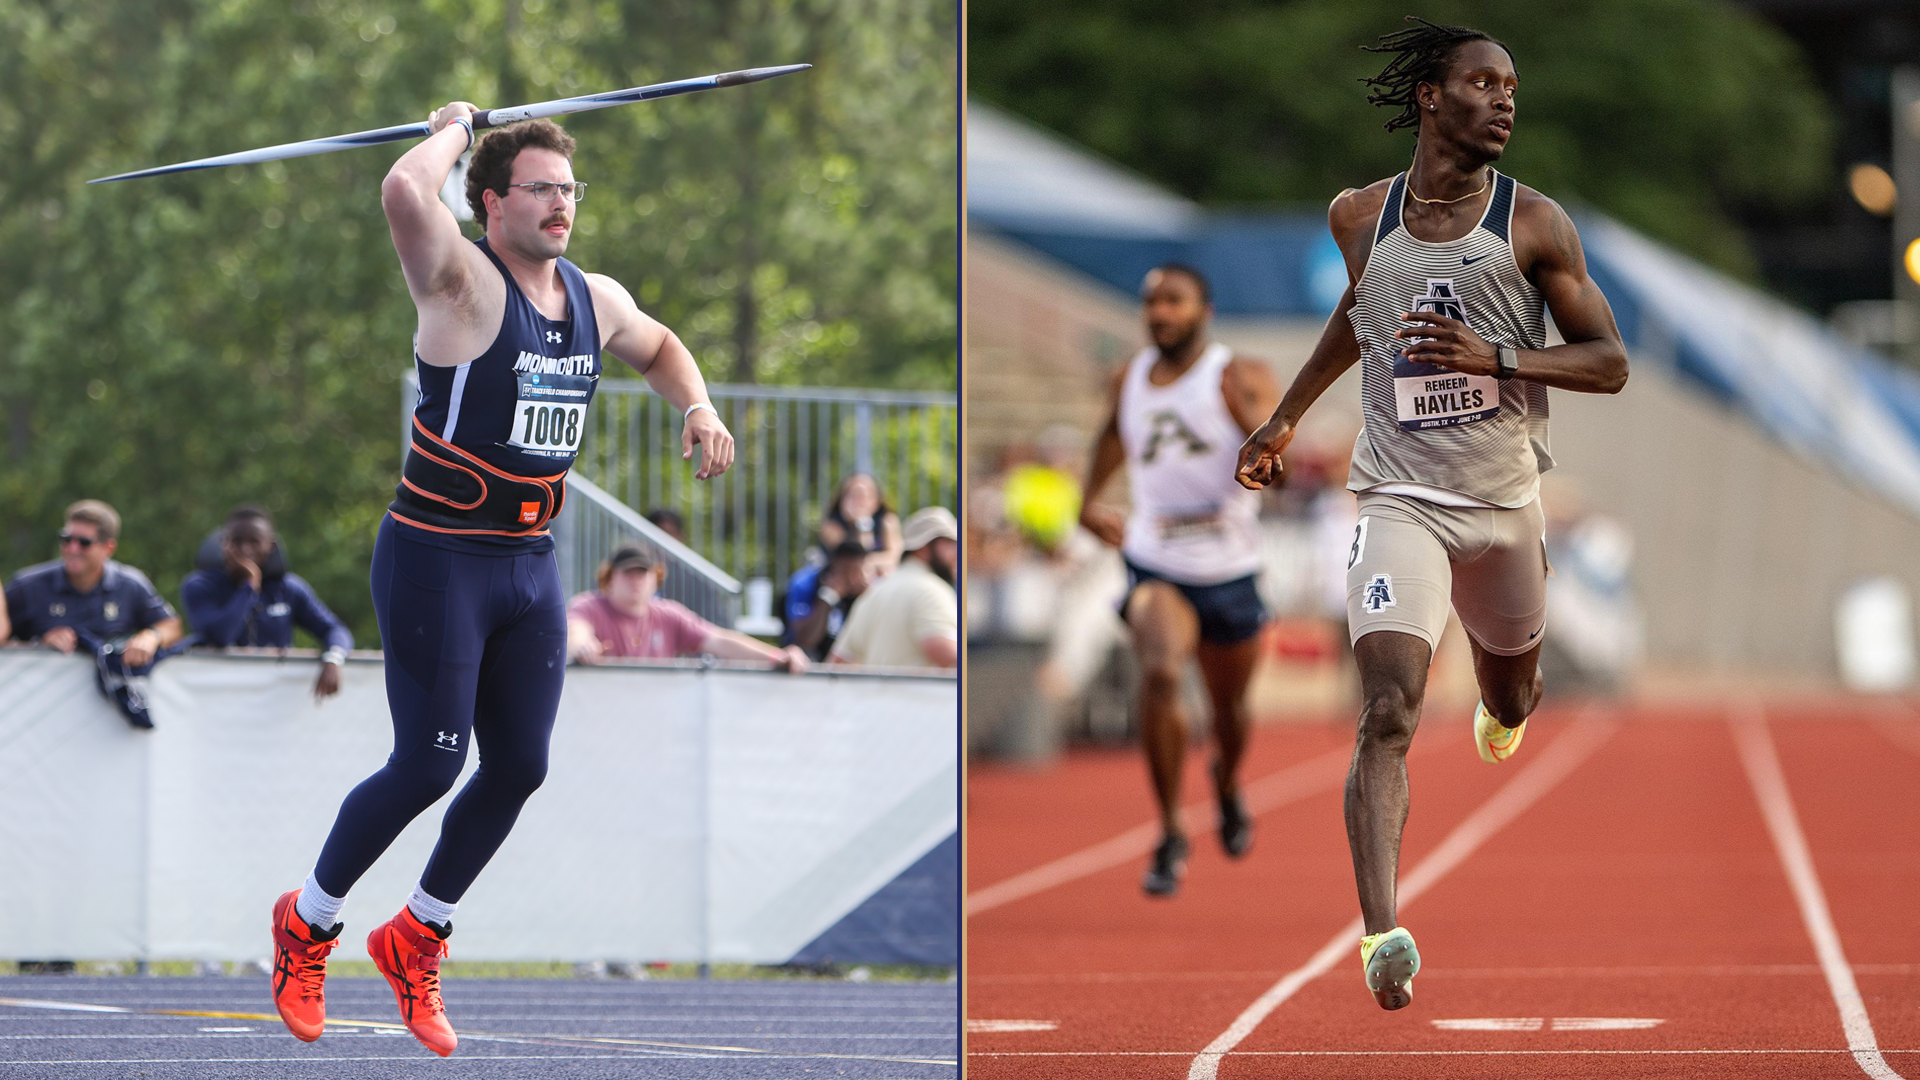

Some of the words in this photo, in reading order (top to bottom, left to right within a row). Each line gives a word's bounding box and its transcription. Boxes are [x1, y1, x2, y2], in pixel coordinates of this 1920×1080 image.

[514, 351, 593, 375] MONMOUTH
[1425, 376, 1468, 392] REHEEM
[1414, 388, 1484, 416] HAYLES
[523, 405, 579, 447] 1008
[1420, 420, 1441, 428] AUSTIN,
[1457, 415, 1471, 424] JUNE
